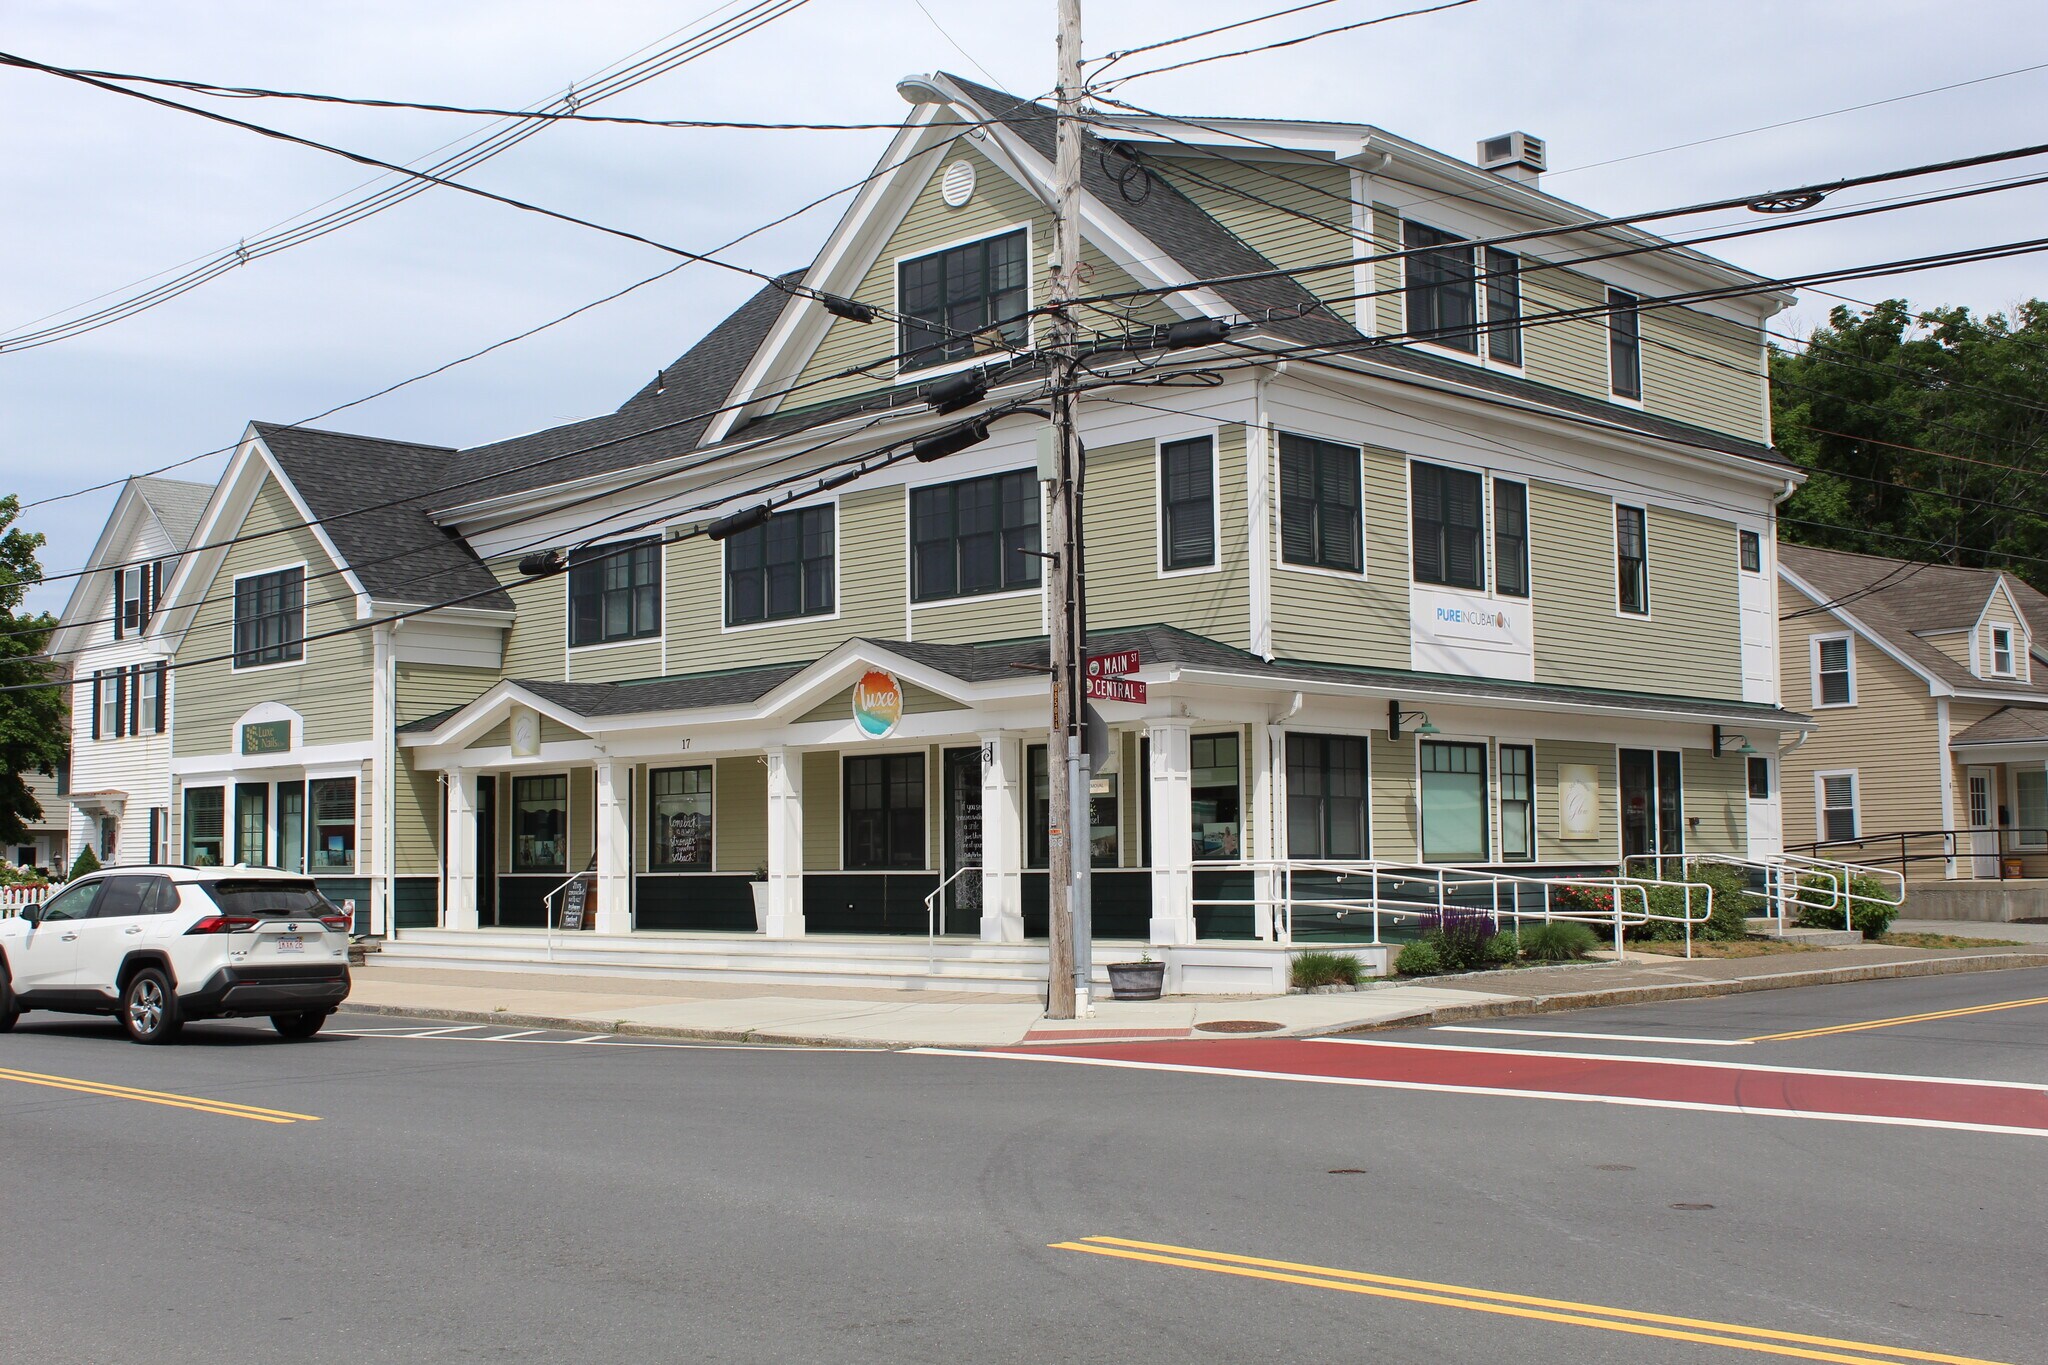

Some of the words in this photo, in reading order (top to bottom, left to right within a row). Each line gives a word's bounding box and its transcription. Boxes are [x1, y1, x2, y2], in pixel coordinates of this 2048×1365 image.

[1104, 655, 1127, 674] MAIN
[1131, 653, 1137, 662] ST
[1095, 679, 1136, 699] CENTRAL
[1139, 684, 1145, 693] ST
[258, 727, 274, 737] Luxe
[262, 737, 278, 747] Nails
[682, 739, 691, 749] 17
